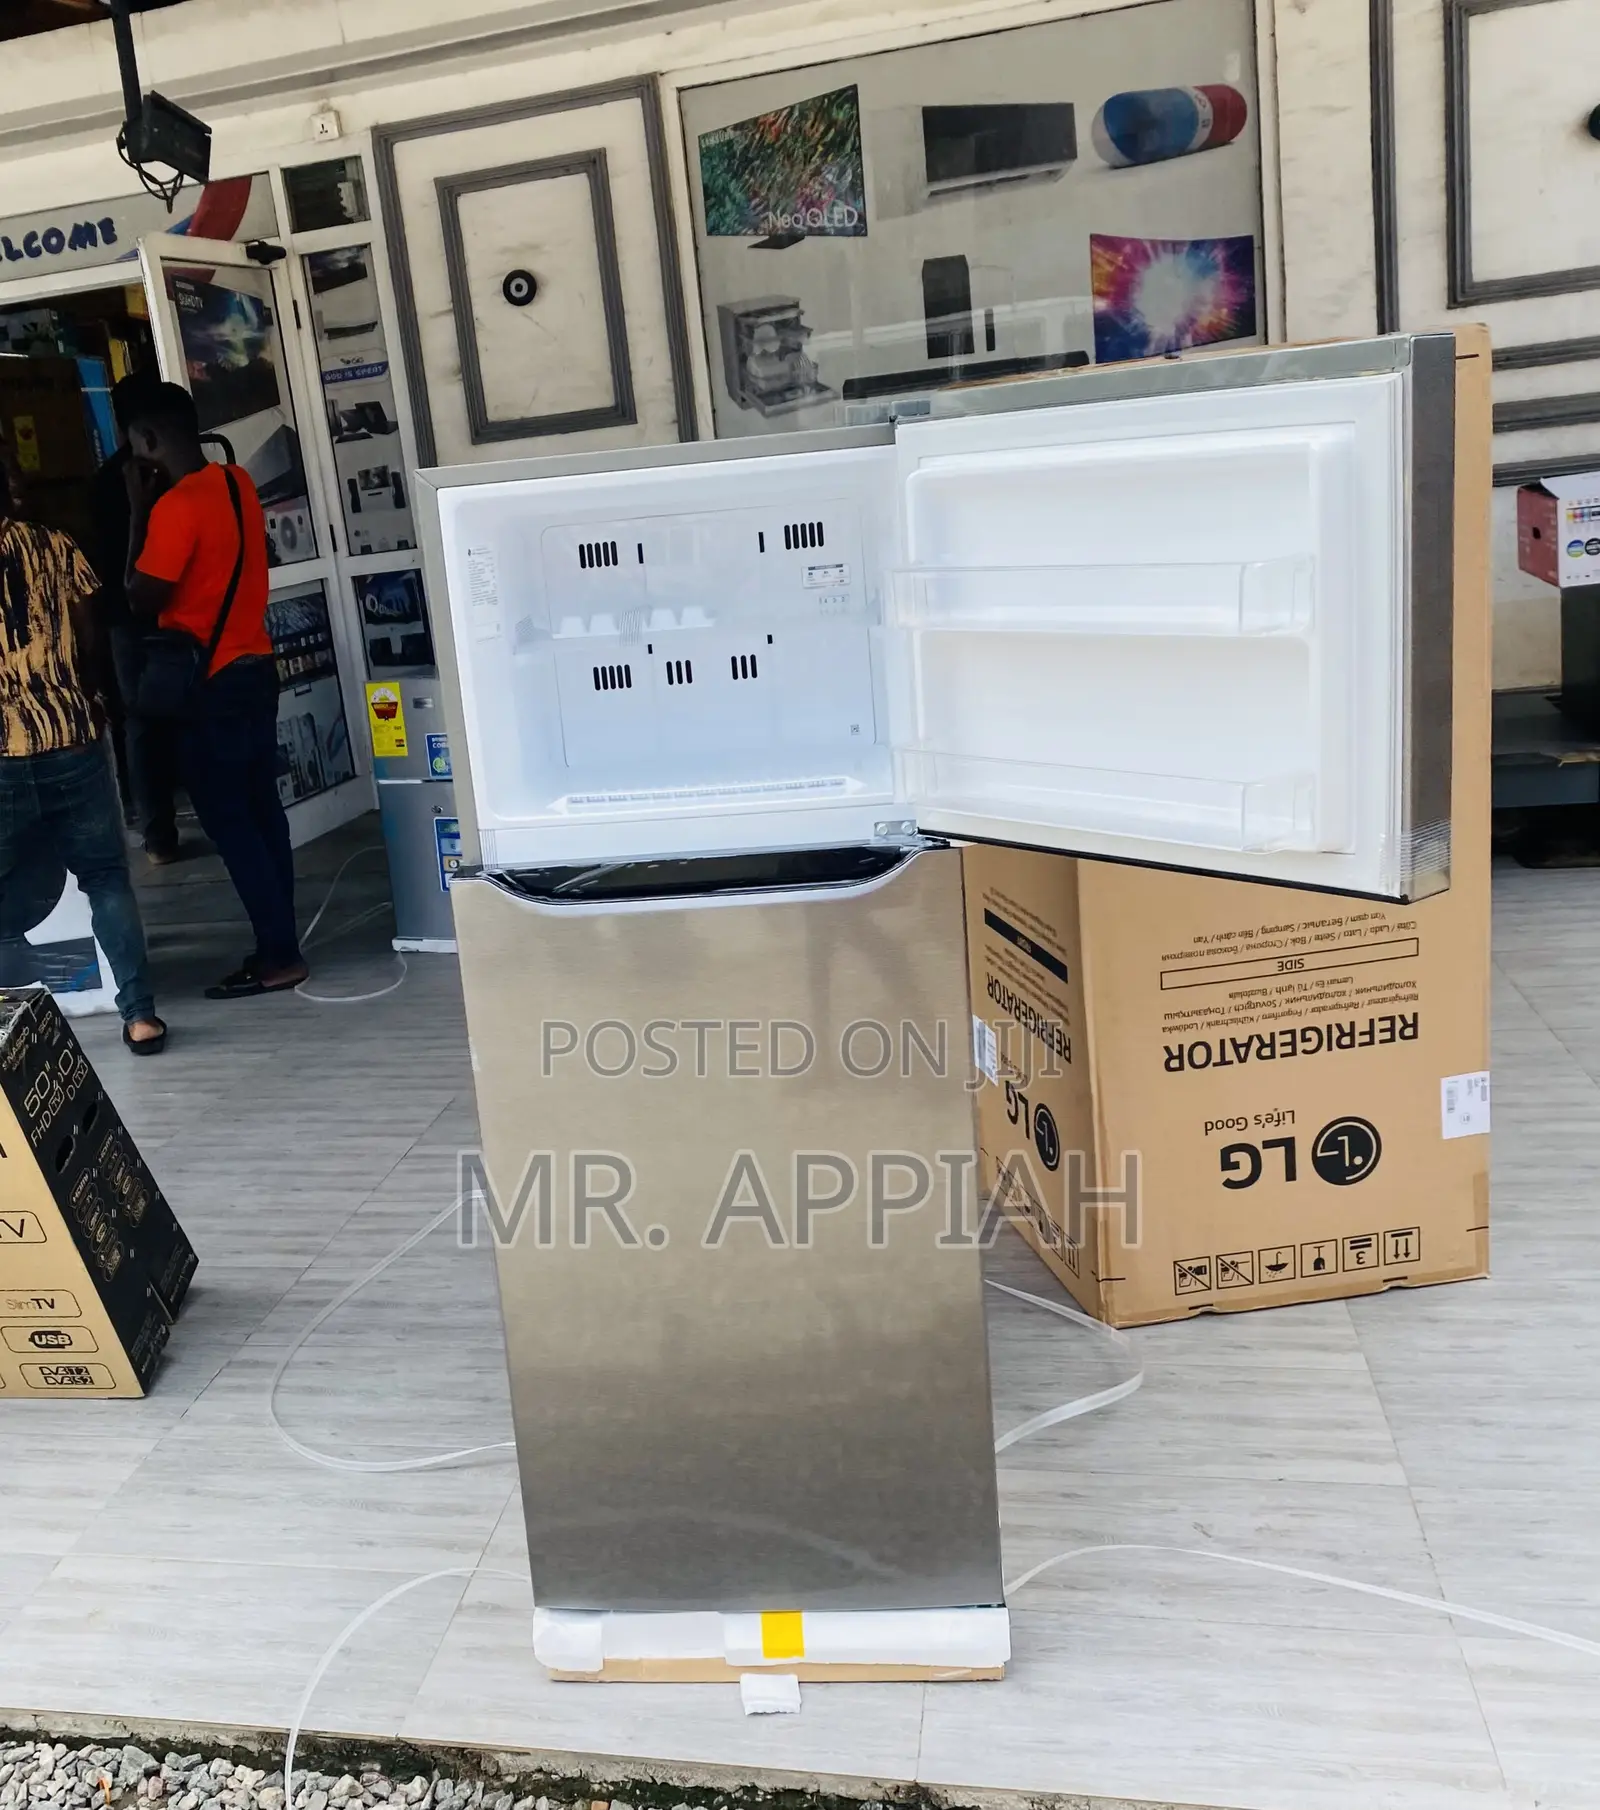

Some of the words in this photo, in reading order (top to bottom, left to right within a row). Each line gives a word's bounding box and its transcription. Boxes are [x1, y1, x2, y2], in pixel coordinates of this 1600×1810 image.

[768, 210, 804, 229] Neo
[806, 205, 859, 228] QLED
[0, 216, 118, 262] LCOME
[1290, 936, 1307, 946] Bok
[1277, 958, 1305, 972] SIDE
[986, 971, 1073, 1065] REFRIGERATOR
[1162, 1011, 1420, 1073] REFRIGERATOR
[1004, 1080, 1031, 1140] LG
[1253, 1109, 1296, 1129] Life's
[30, 1110, 52, 1148] FHD
[1203, 1116, 1248, 1136] Good
[1219, 1136, 1297, 1190] LG
[34, 1334, 71, 1346] USB
